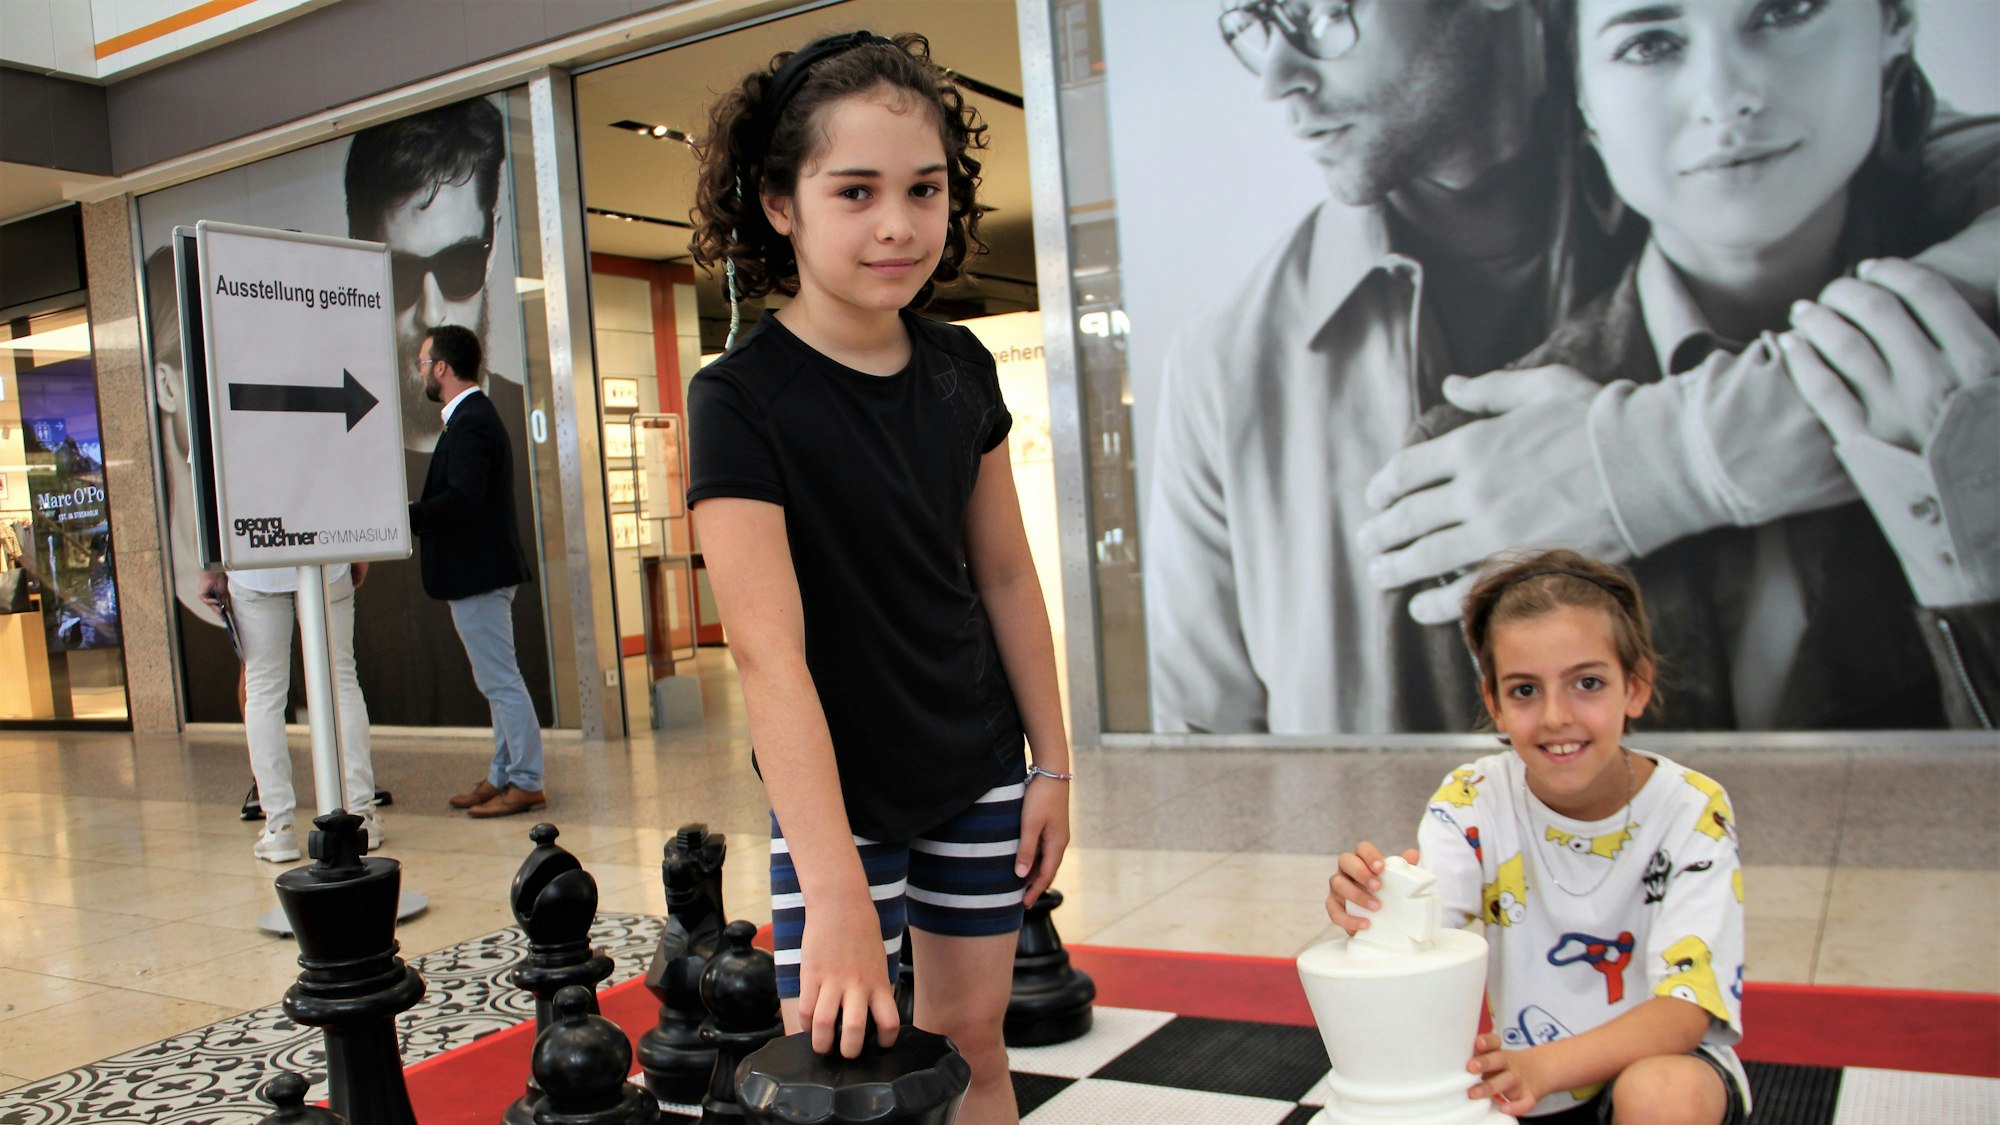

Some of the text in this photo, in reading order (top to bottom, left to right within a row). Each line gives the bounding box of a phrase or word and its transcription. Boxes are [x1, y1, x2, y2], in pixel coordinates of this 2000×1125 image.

[216, 274, 382, 309] Ausstellung geöffnet
[38, 493, 72, 510] Marc
[234, 516, 282, 537] georg
[250, 527, 398, 549] büchner GYMNASIUM
